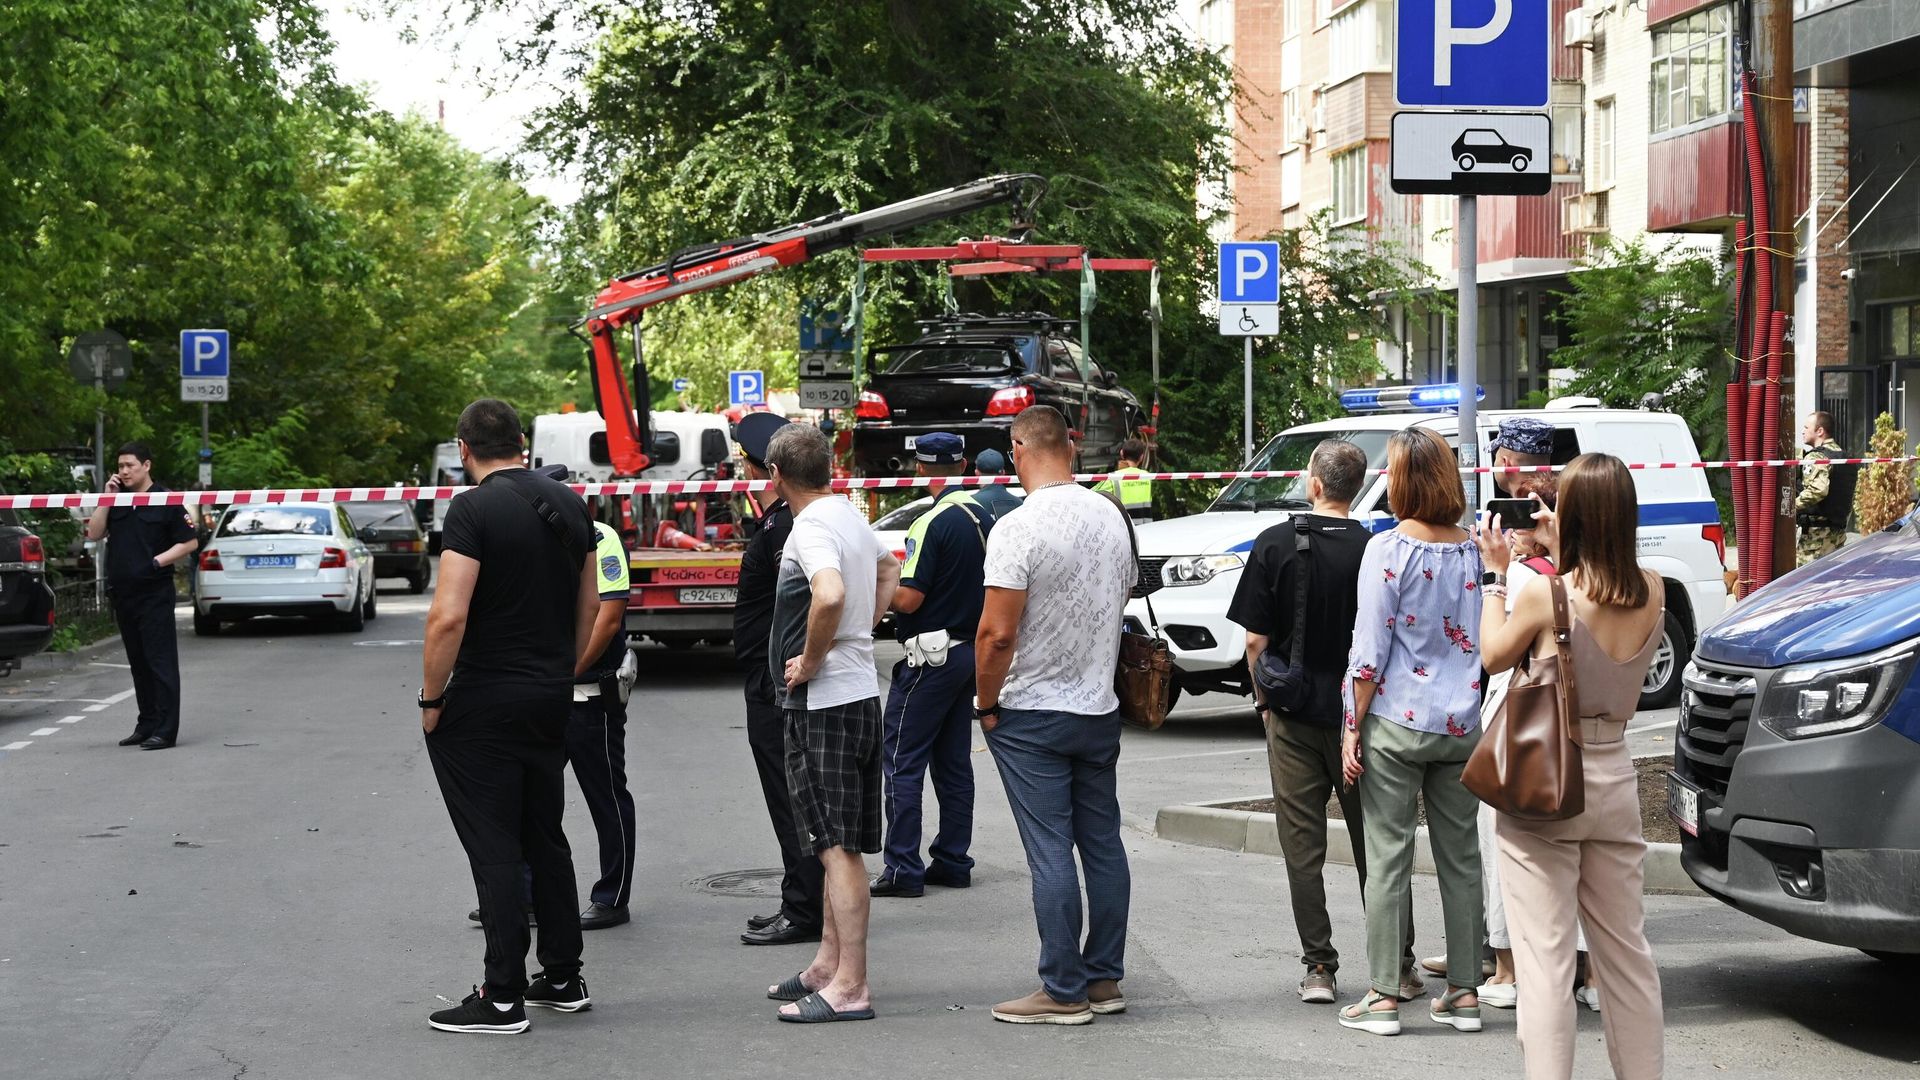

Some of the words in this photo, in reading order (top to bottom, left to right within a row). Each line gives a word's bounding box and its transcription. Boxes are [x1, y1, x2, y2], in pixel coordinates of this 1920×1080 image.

[1434, 0, 1513, 86] P
[1236, 249, 1268, 297] P
[194, 336, 220, 372] P
[209, 385, 224, 395] 20
[738, 375, 758, 402] P
[806, 391, 815, 399] 10
[818, 390, 829, 400] 15
[831, 390, 849, 401] 20
[258, 556, 280, 565] 3030
[662, 568, 740, 582] Чайка-Сер
[683, 590, 726, 602] С924ЕХ
